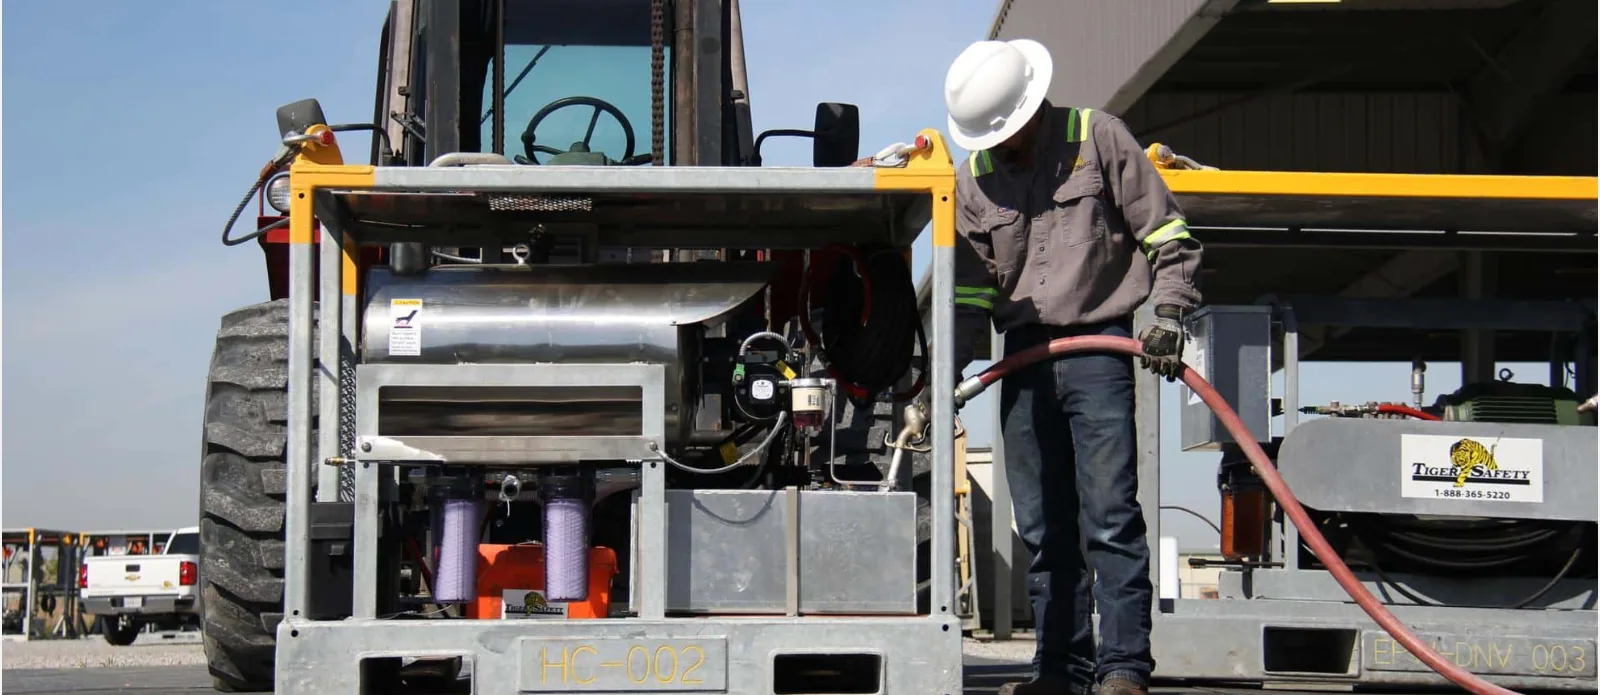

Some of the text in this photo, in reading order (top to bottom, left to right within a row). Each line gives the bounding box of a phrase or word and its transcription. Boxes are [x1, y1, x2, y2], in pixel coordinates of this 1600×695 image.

[1412, 462, 1530, 480] TIGER SAFETY
[1434, 489, 1511, 500] 1-888-365-5220
[540, 645, 706, 684] HC-002
[1532, 644, 1586, 672] 003
